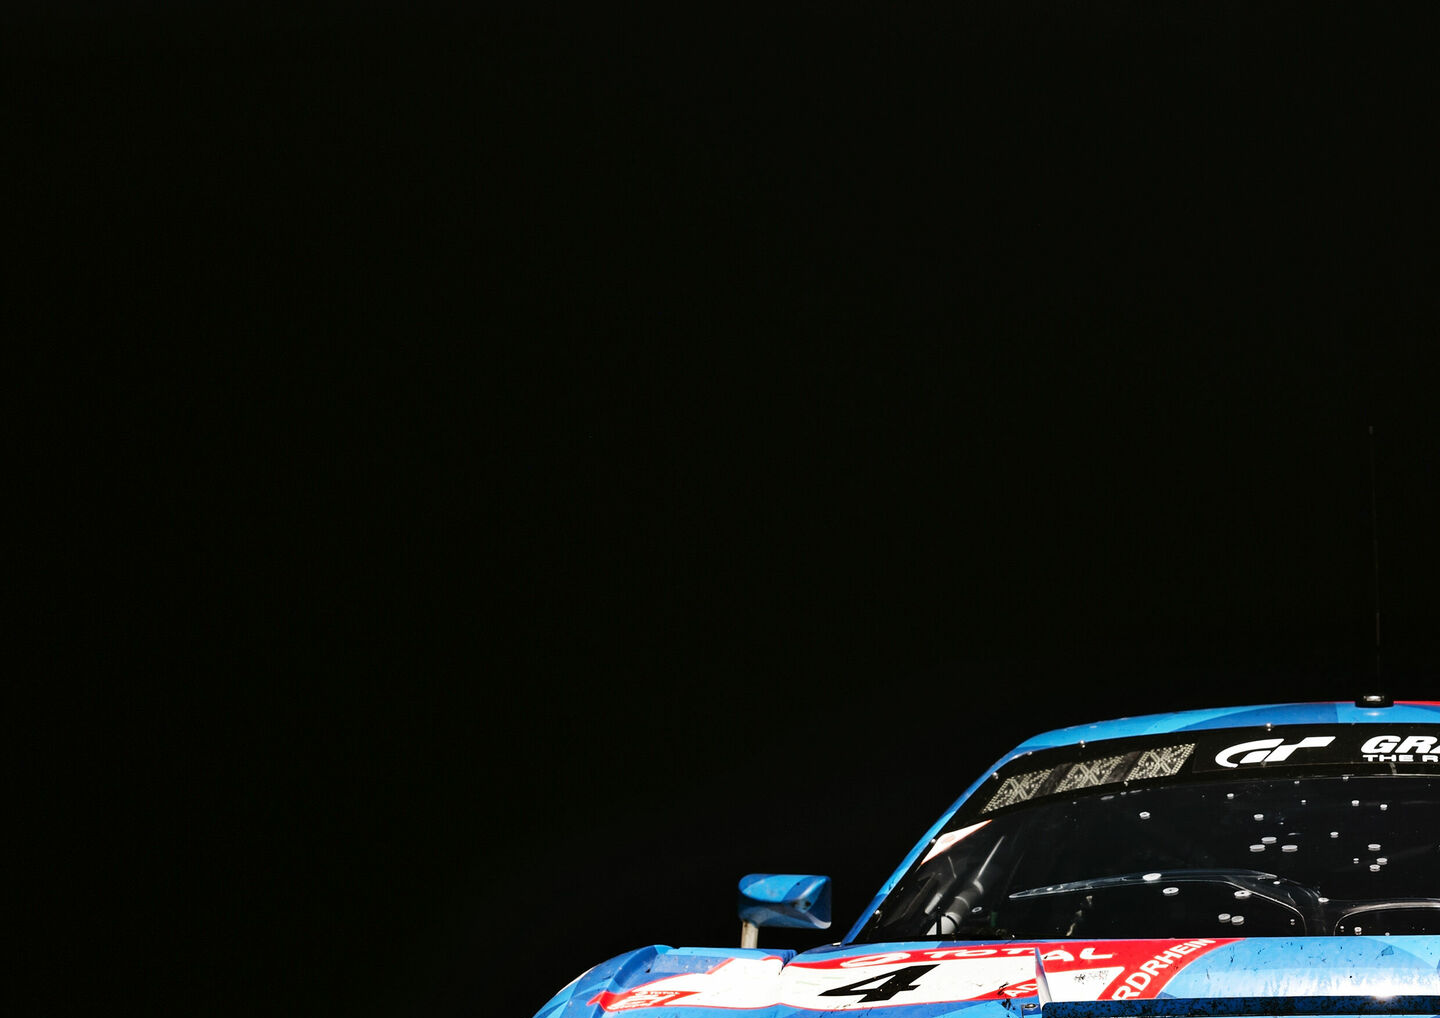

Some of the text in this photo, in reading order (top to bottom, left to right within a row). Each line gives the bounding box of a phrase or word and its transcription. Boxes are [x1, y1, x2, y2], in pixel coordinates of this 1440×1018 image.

[1362, 754, 1414, 763] THE
[923, 946, 1116, 963] TOTAL
[817, 963, 941, 1004] 4
